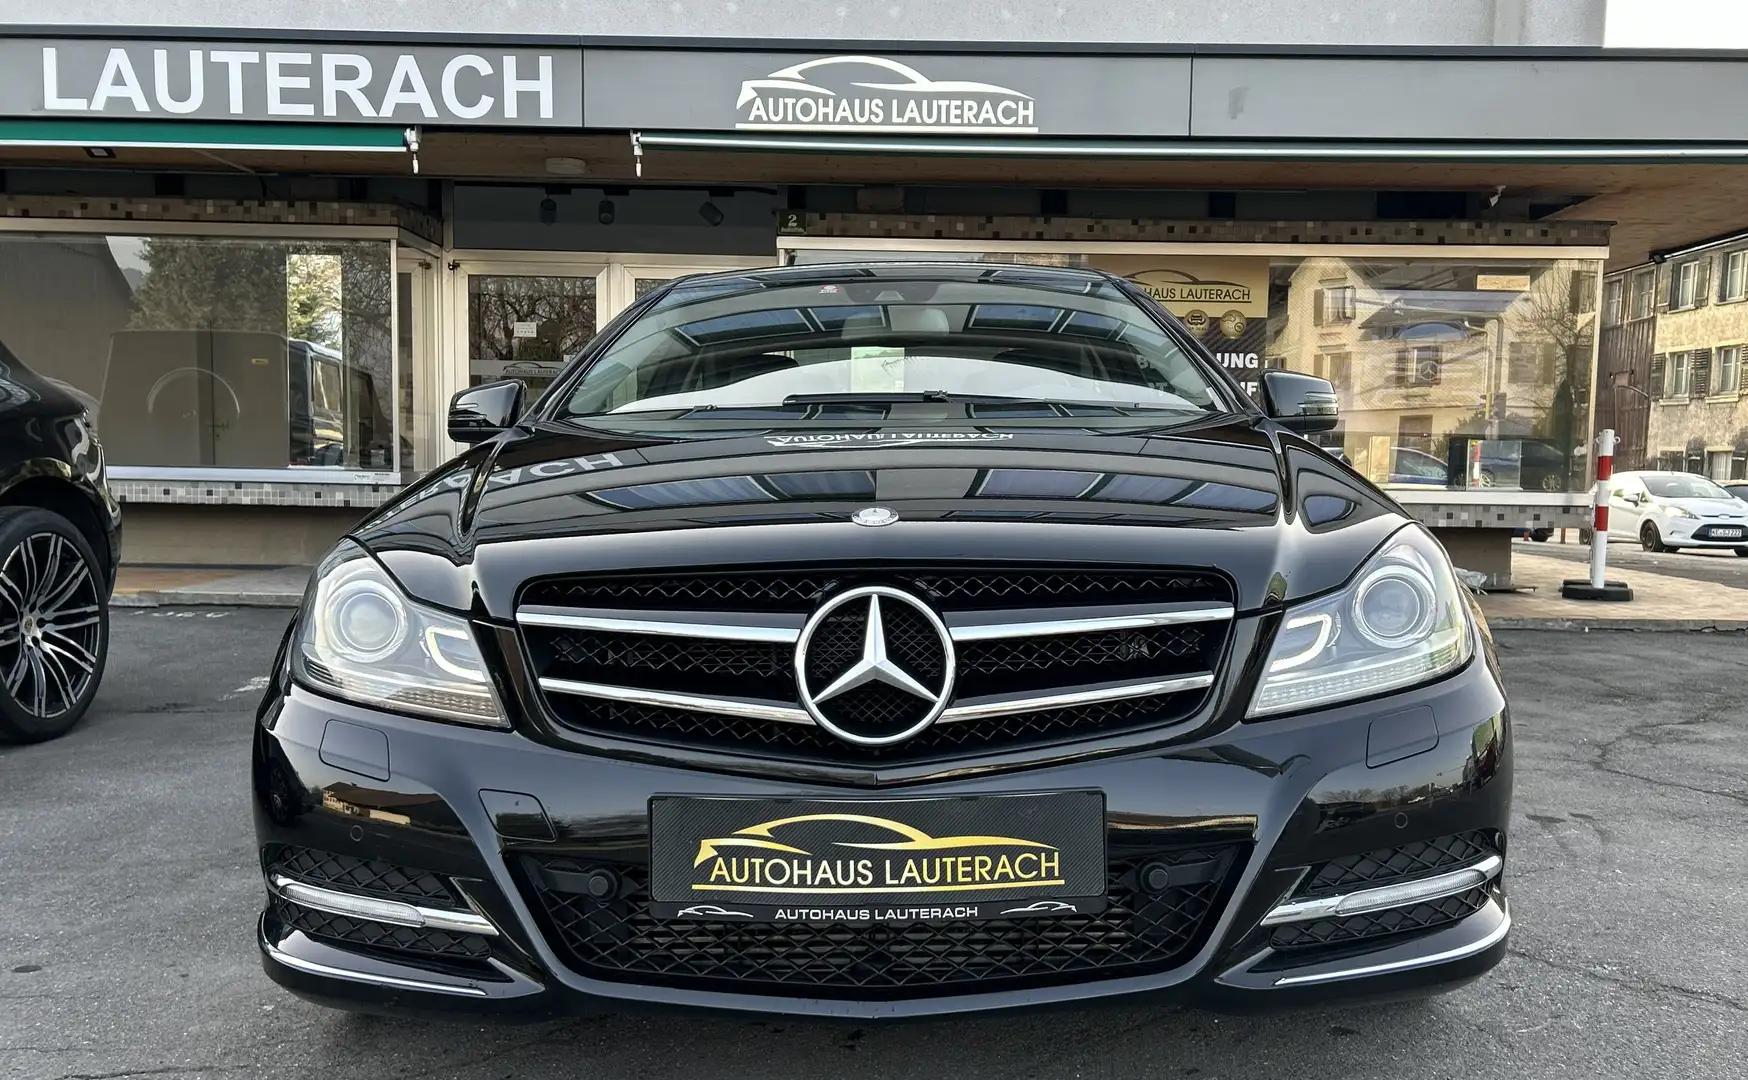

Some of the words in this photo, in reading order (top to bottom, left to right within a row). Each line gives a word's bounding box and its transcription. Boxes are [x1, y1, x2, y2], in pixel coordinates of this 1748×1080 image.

[42, 47, 553, 119] LAUTERACH
[748, 96, 884, 123] AUTOHAUS
[891, 98, 1034, 126] LAUTERACH
[788, 214, 798, 227] 2
[1180, 288, 1251, 301] LAUTERACH
[709, 855, 873, 886] AUTOHAUS
[884, 851, 1060, 884] LAUTERACH
[775, 908, 871, 921] AUTOHAUS
[875, 906, 979, 920] LAUTERACH
